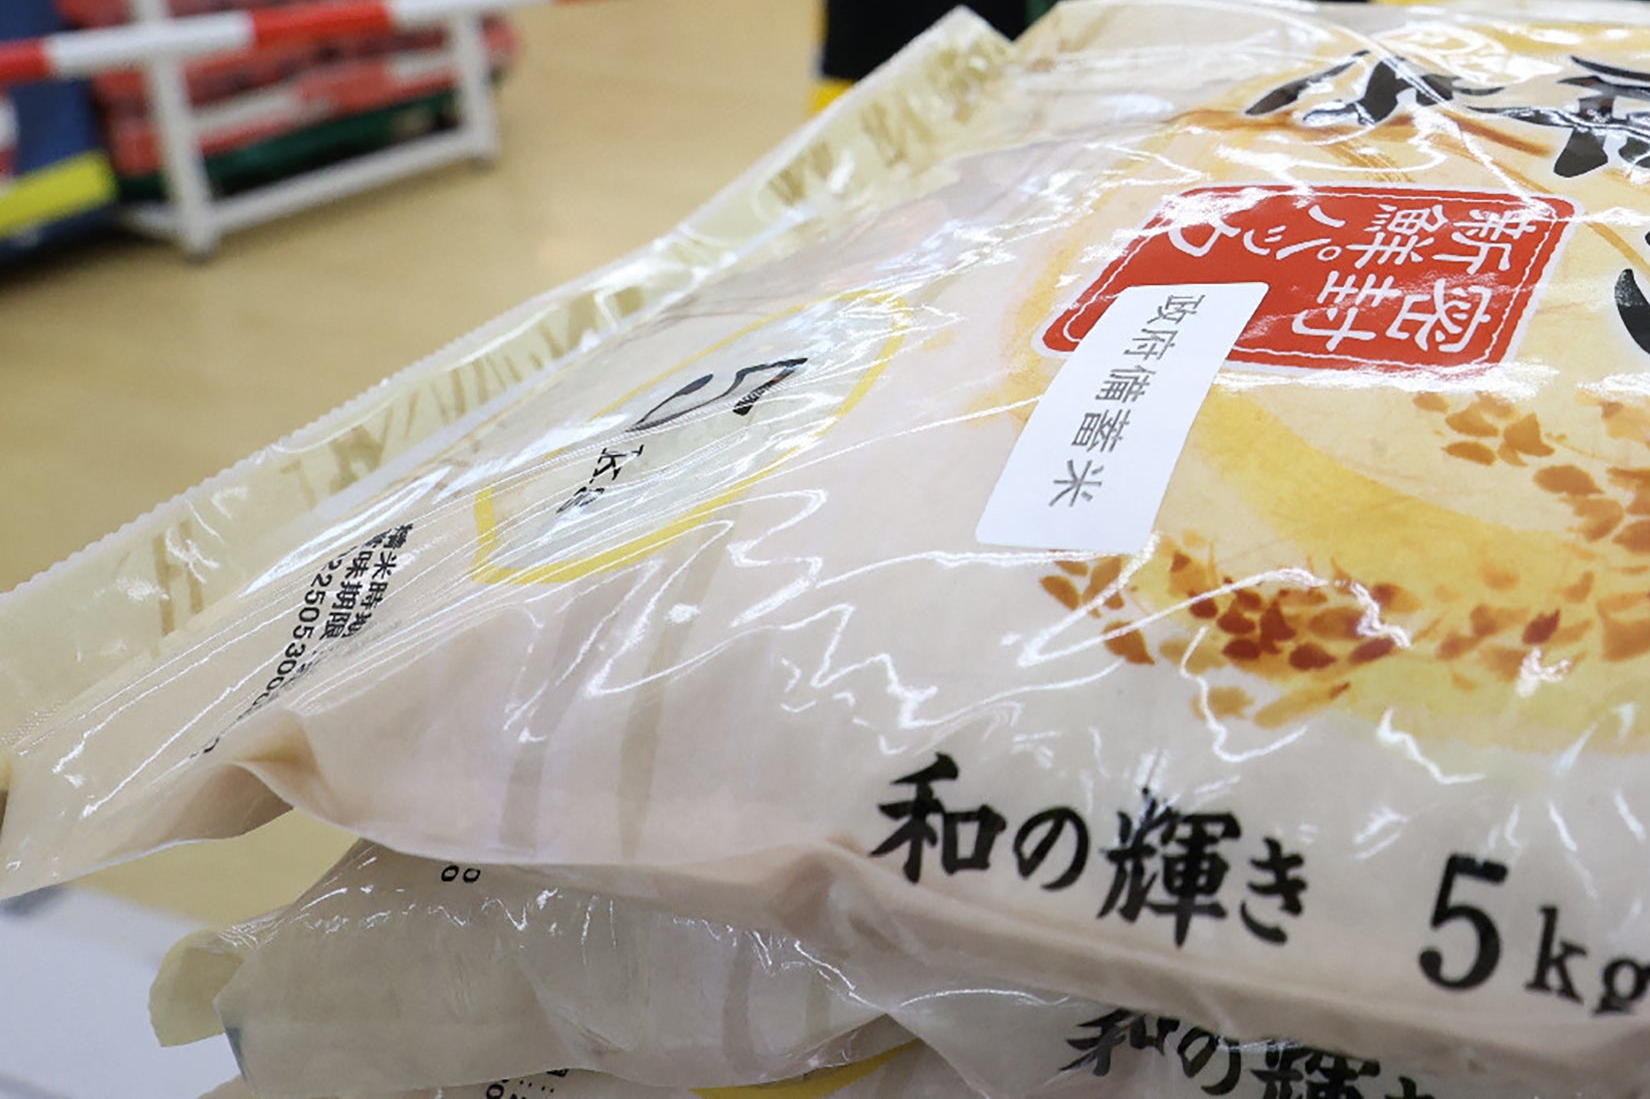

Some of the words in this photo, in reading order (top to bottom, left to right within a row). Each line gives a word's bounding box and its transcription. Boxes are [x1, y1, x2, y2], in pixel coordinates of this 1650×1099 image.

[1168, 203, 1537, 275] 新鮮パック
[1292, 271, 1492, 352] 密封
[1050, 293, 1206, 508] 政府備蓄米
[871, 753, 1307, 947] 和の輝き
